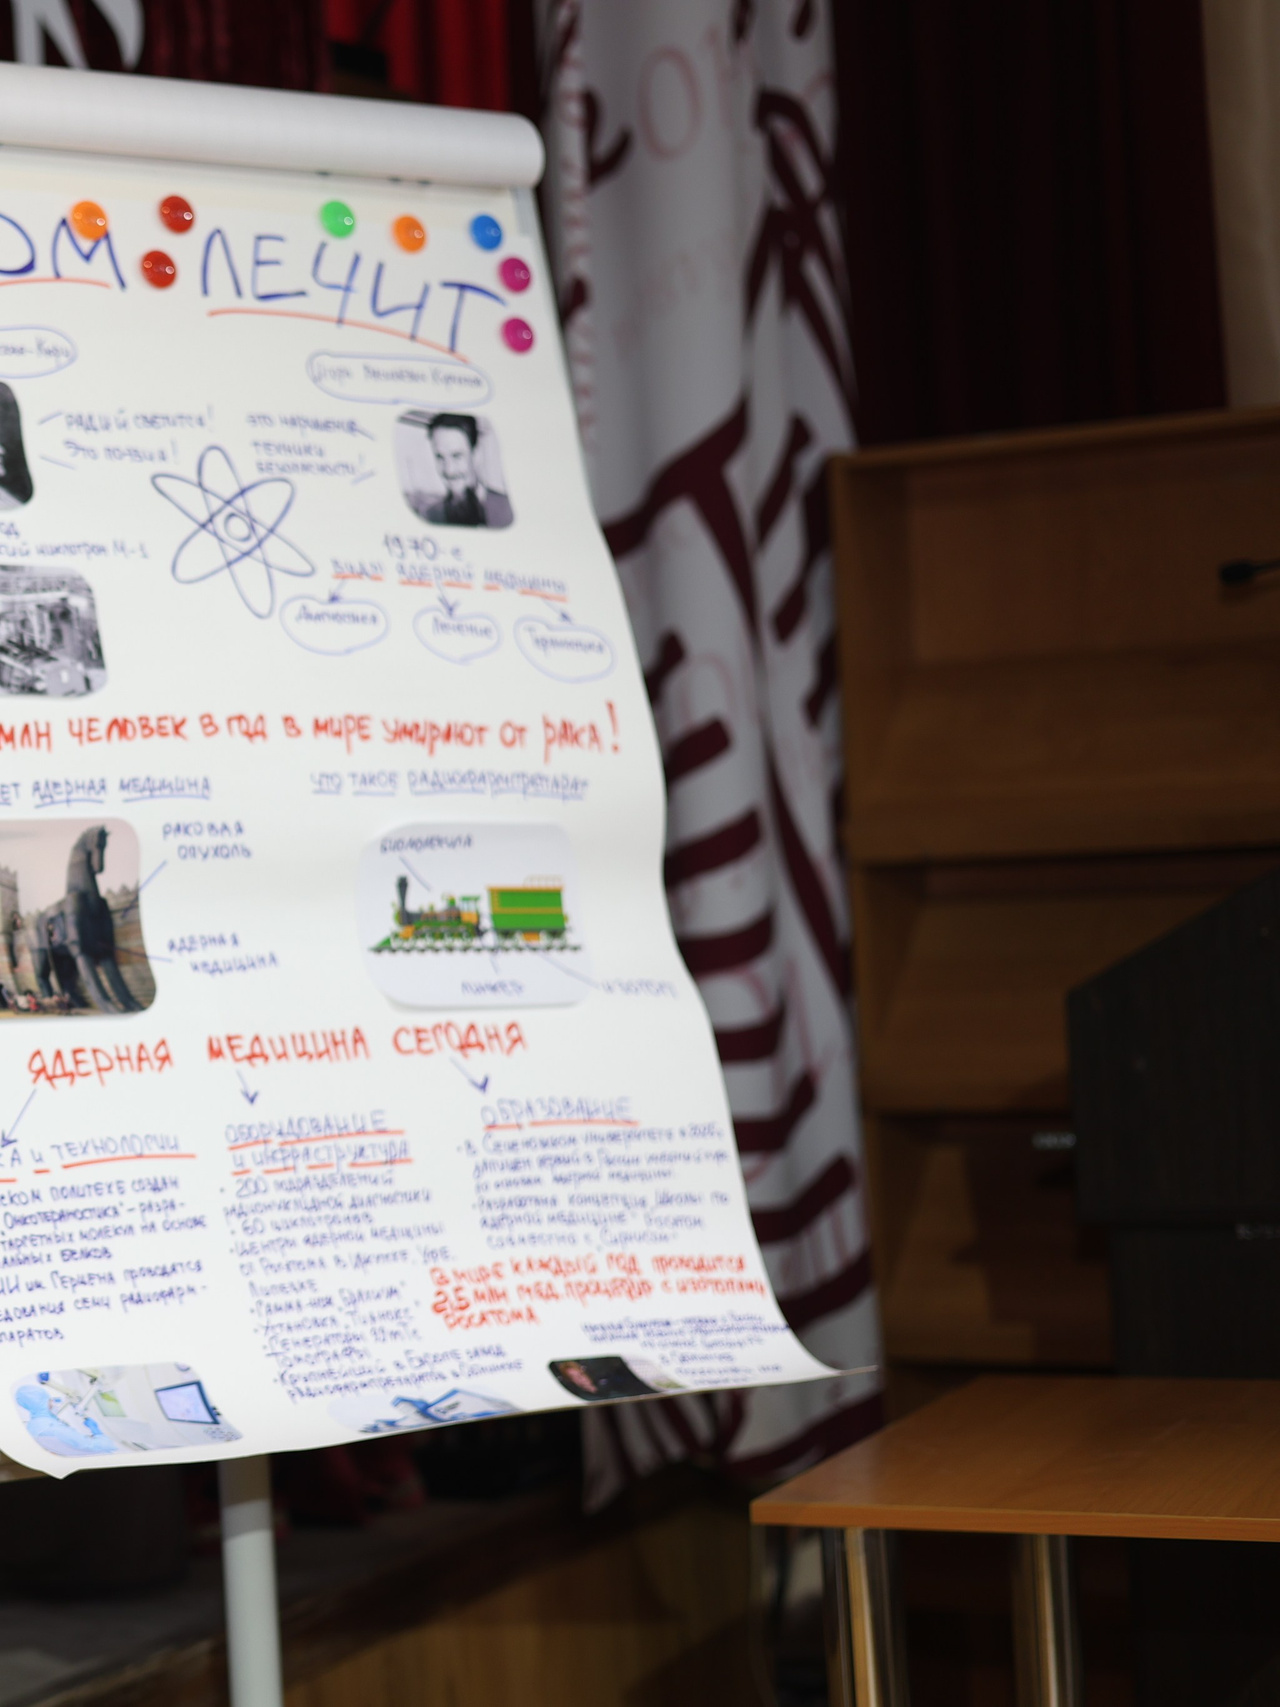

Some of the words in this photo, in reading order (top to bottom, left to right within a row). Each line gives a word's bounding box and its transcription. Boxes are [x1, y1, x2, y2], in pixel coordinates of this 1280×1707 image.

[202, 227, 508, 353] ЛЕЧИТ
[67, 715, 189, 746] ЧЕЛОВЕК
[199, 712, 220, 738] В
[226, 712, 269, 743] ГОД
[281, 714, 303, 739] В
[498, 720, 529, 749] ОТ
[31, 777, 107, 806] ЯДЕРНАЯ
[119, 775, 211, 801] МЕДИЦИНА
[310, 772, 343, 792] ЧТО
[351, 771, 400, 792] ТАКОЕ
[162, 820, 245, 841] РАКОВАЯ
[176, 843, 253, 862] ОПУХОЛЬ
[167, 932, 241, 957] ЯДЕРНАЯ
[27, 1037, 174, 1089] ЯДЕРНАЯ
[206, 1024, 372, 1068] МЕДИЦИНА
[391, 1019, 530, 1058] СЕГОДНЯ
[50, 1133, 181, 1160] ТЕХНОЛОГИИ
[235, 1175, 269, 1199] 200
[241, 1217, 266, 1237] 60
